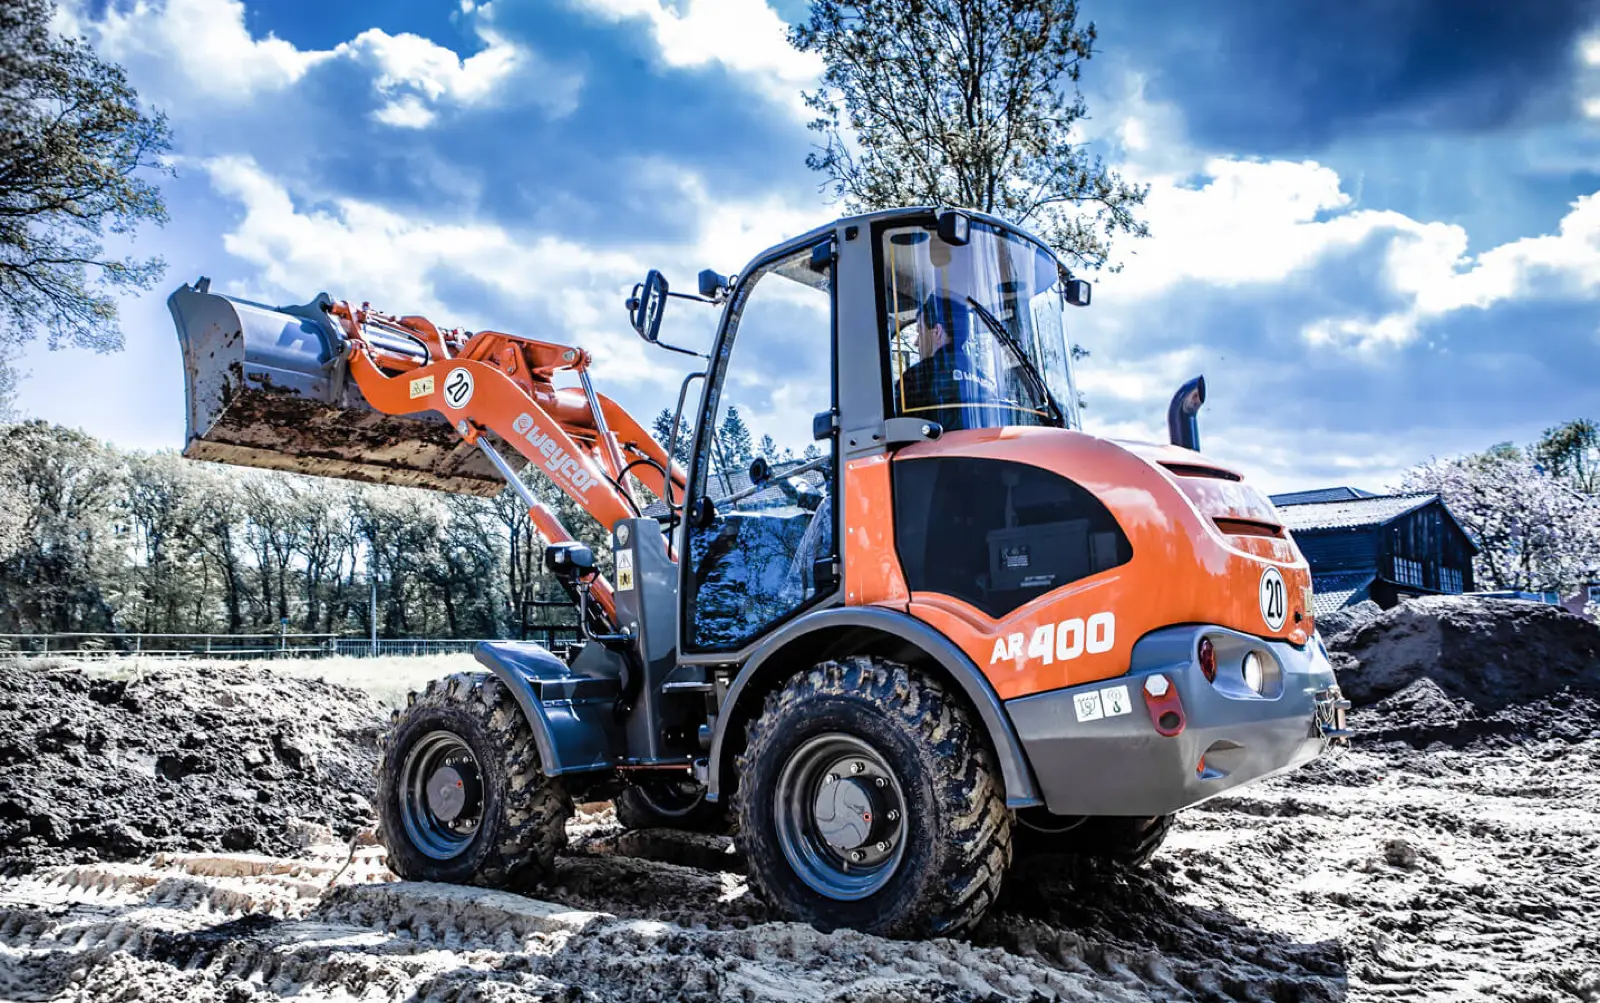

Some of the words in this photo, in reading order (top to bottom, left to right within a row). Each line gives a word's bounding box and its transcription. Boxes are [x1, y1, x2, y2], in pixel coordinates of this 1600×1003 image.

[447, 373, 469, 403] 20
[526, 429, 599, 492] weycor
[1266, 579, 1283, 618] 20
